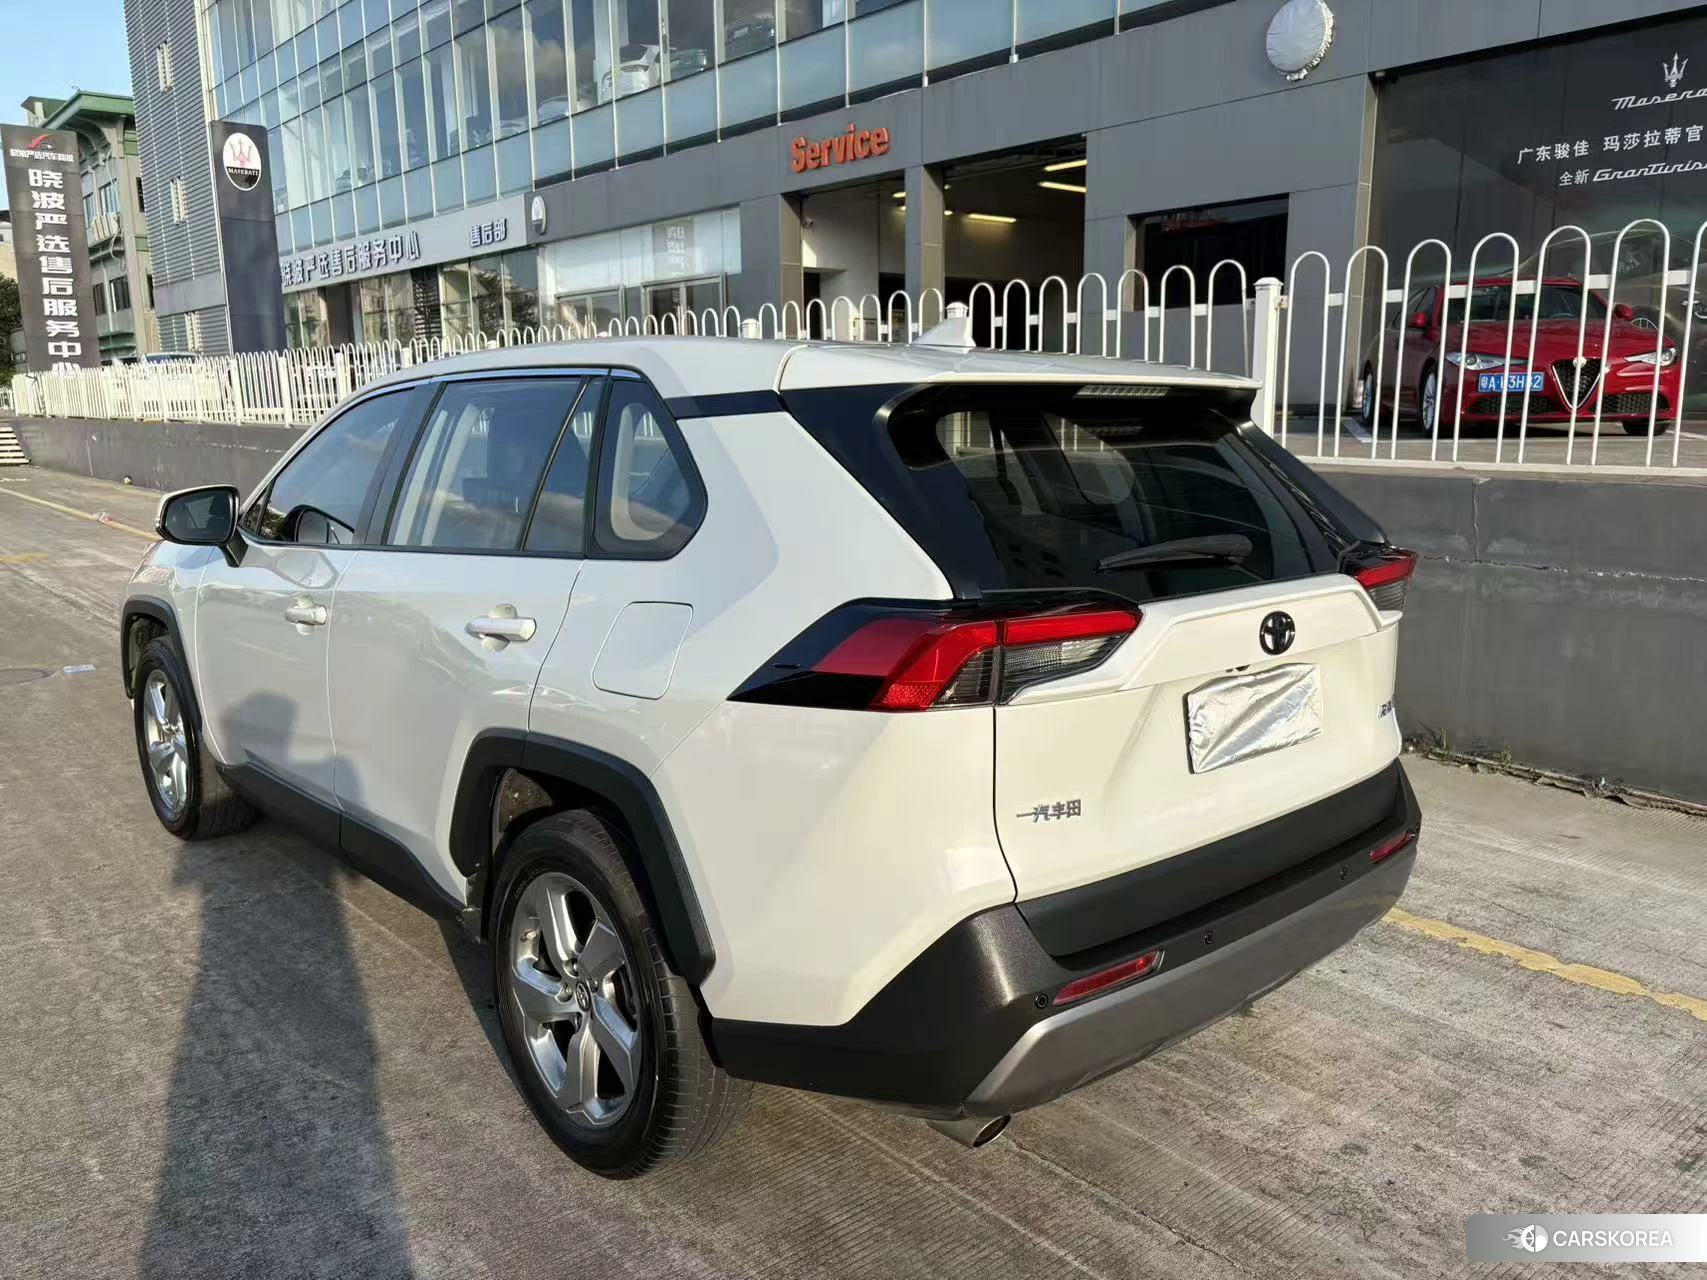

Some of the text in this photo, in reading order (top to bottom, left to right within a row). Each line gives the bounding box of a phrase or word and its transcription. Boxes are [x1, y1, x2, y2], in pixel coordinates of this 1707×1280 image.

[791, 123, 888, 173] Service
[1517, 124, 1704, 165] 广东骏佳 玛莎拉蒂官
[228, 167, 259, 176] MASERATI
[1559, 168, 1590, 186] 全新
[470, 217, 508, 248] 售后部
